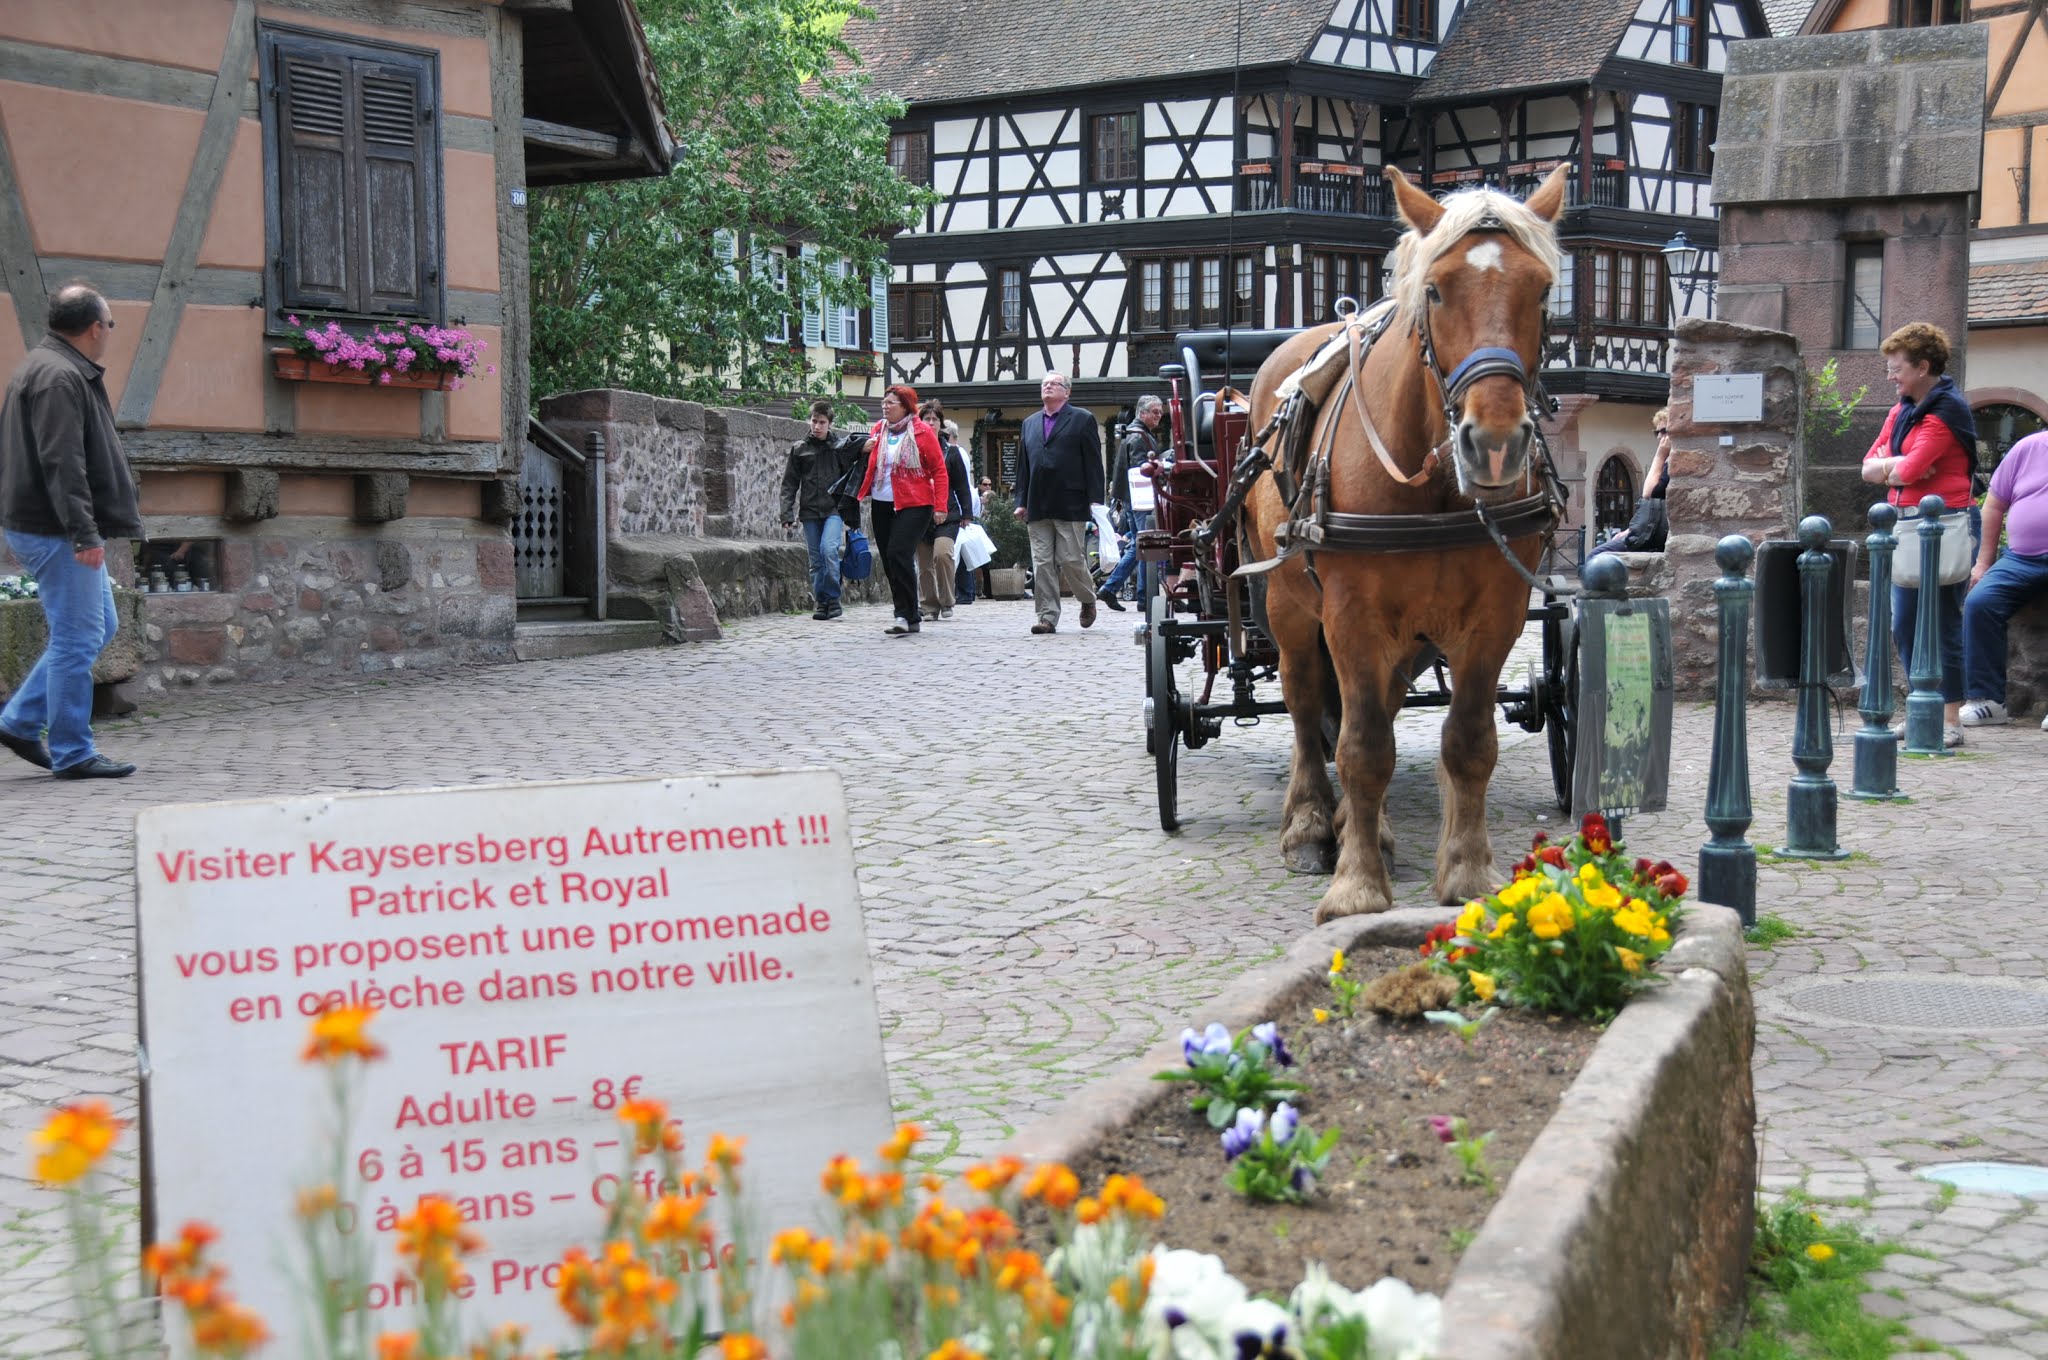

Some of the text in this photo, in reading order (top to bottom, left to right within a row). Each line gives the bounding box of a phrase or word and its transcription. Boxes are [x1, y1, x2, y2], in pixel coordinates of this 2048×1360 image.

[513, 192, 526, 205] 80
[156, 815, 831, 884] Visiter Kaysersberg Autrement !!!
[350, 867, 669, 918] Patrick et Royal
[175, 903, 830, 978] vous proposent une promenade
[229, 951, 794, 1023] en calèche dans notre ville.
[439, 1033, 567, 1075] TARIF
[395, 1088, 536, 1129] Adulte
[592, 1075, 643, 1112] 8€
[358, 1149, 384, 1182] 6
[400, 1144, 423, 1179] à
[441, 1139, 487, 1174] 15
[502, 1137, 579, 1168] ans
[376, 1197, 400, 1232] à
[458, 1190, 535, 1223] ans
[329, 1272, 476, 1312] one
